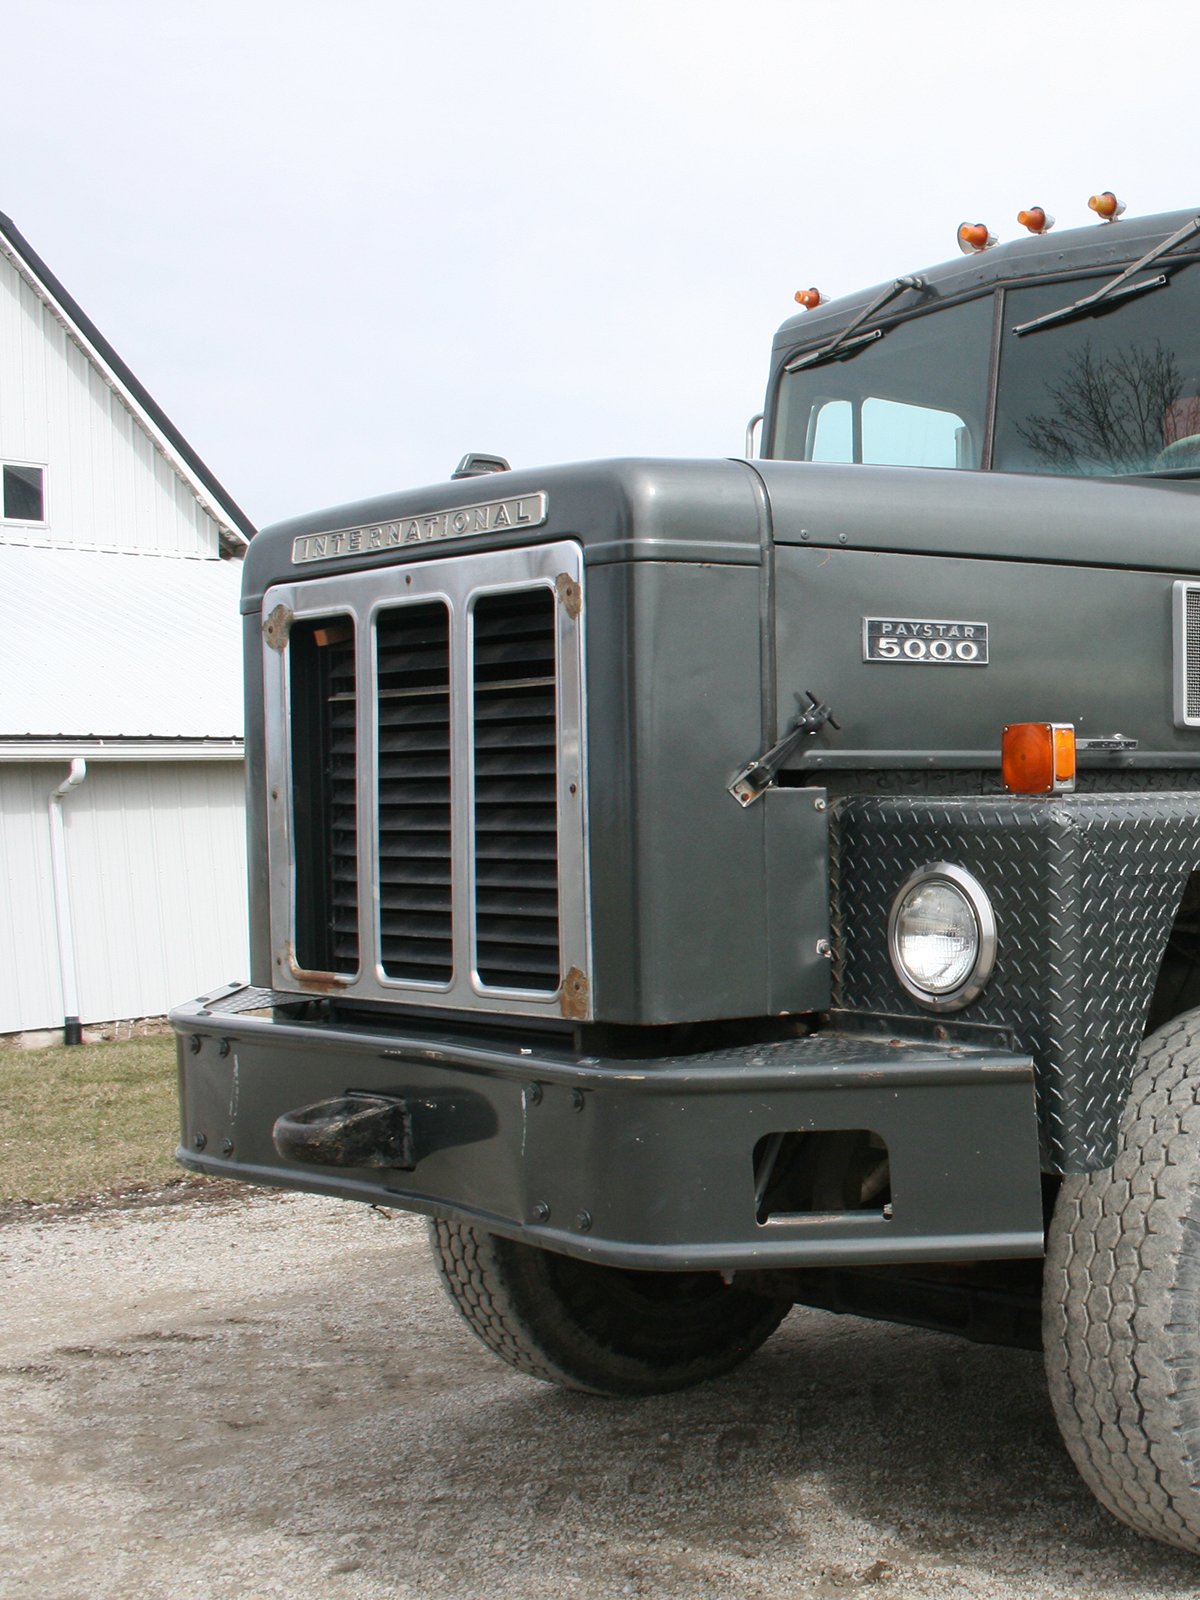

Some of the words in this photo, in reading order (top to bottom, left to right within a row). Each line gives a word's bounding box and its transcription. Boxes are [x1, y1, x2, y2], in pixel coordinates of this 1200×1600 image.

[302, 503, 531, 560] INTERNATIONAL
[882, 623, 975, 638] PAYSTAR
[878, 638, 978, 660] 5000
